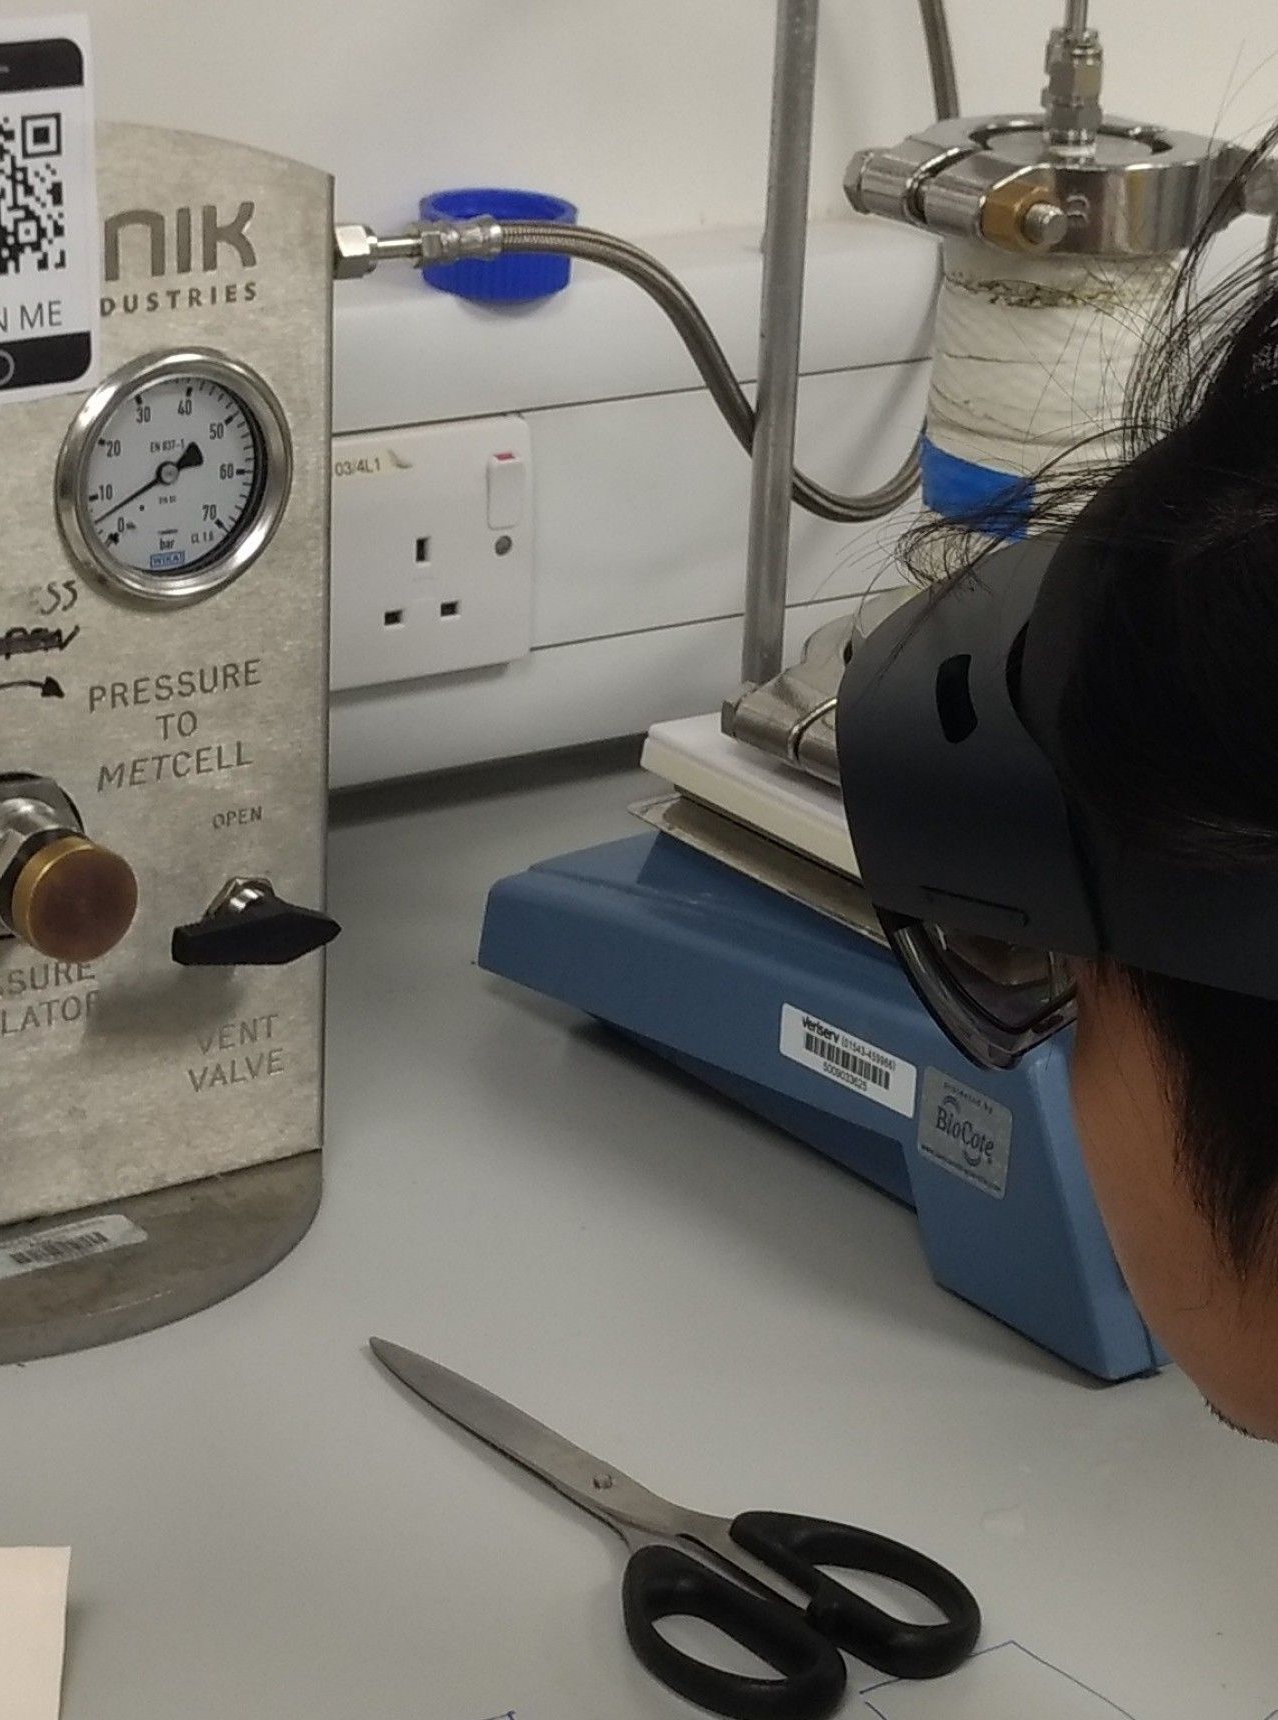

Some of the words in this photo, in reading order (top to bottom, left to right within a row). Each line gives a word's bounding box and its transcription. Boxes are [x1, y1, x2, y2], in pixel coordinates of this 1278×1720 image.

[22, 300, 62, 328] ME
[136, 406, 151, 423] 30
[178, 400, 192, 415] 40
[209, 423, 224, 440] 50
[106, 440, 121, 457] 20
[220, 463, 234, 480] 60
[99, 484, 113, 500] 10
[202, 505, 217, 521] 70
[117, 516, 125, 533] 0
[159, 537, 175, 550] bar
[151, 552, 183, 567] WIKA
[89, 658, 262, 714] PRESSURE
[155, 710, 198, 741] TO
[97, 740, 254, 793] METCELL
[212, 806, 263, 829] OPEN
[197, 1014, 279, 1055] VENT
[188, 1048, 285, 1093] VALVE
[936, 1105, 995, 1157] BioCote
